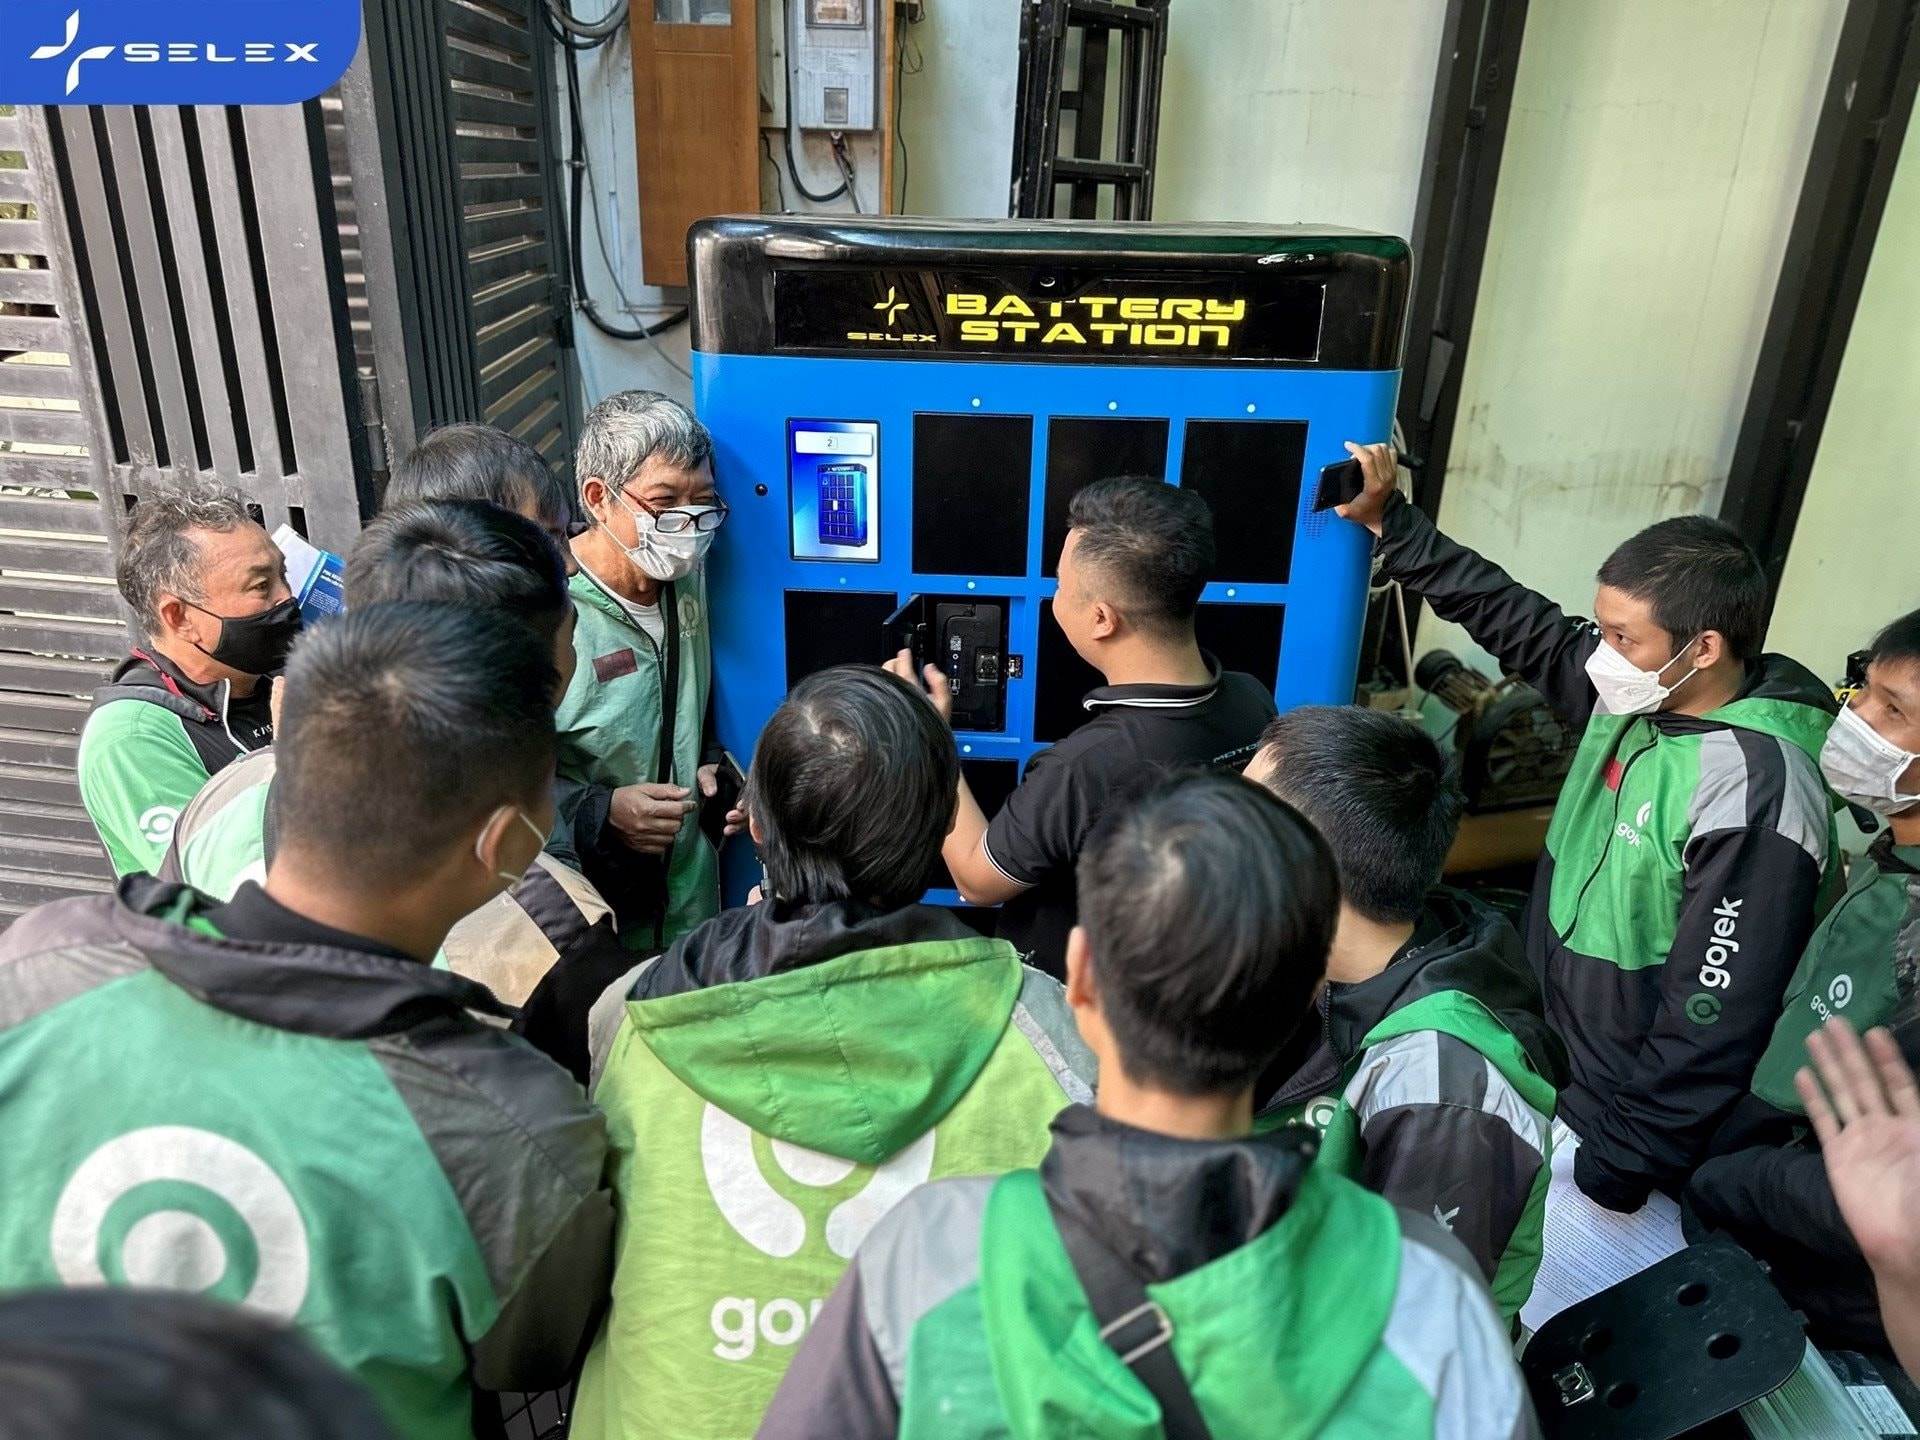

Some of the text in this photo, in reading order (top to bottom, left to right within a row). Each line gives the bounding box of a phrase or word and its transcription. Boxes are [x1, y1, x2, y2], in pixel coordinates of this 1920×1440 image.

[846, 331, 938, 344] SELEX
[960, 320, 1230, 346] STATION
[1698, 896, 1744, 990] gojek
[710, 1296, 824, 1361] go
